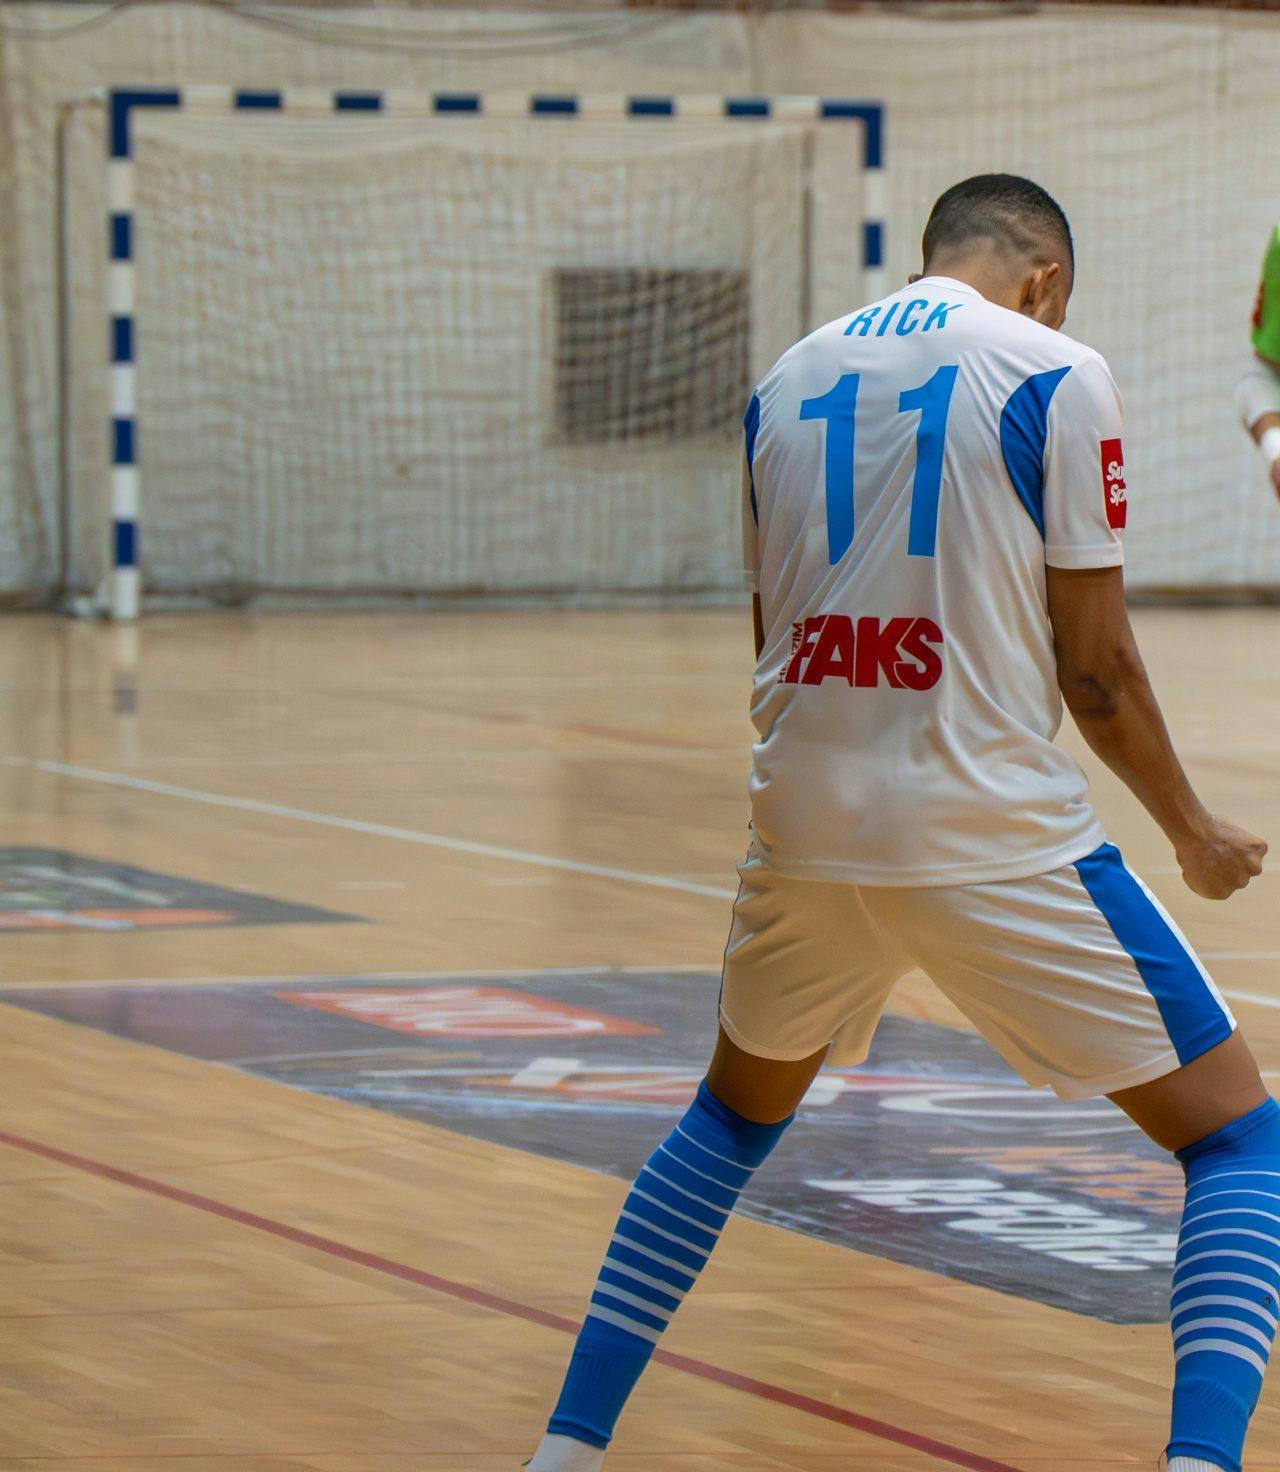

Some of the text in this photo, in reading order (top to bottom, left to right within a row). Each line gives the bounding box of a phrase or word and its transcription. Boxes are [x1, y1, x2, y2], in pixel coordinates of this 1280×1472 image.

[843, 299, 963, 336] RICK
[800, 365, 959, 565] 11
[785, 615, 943, 690] FAKS
